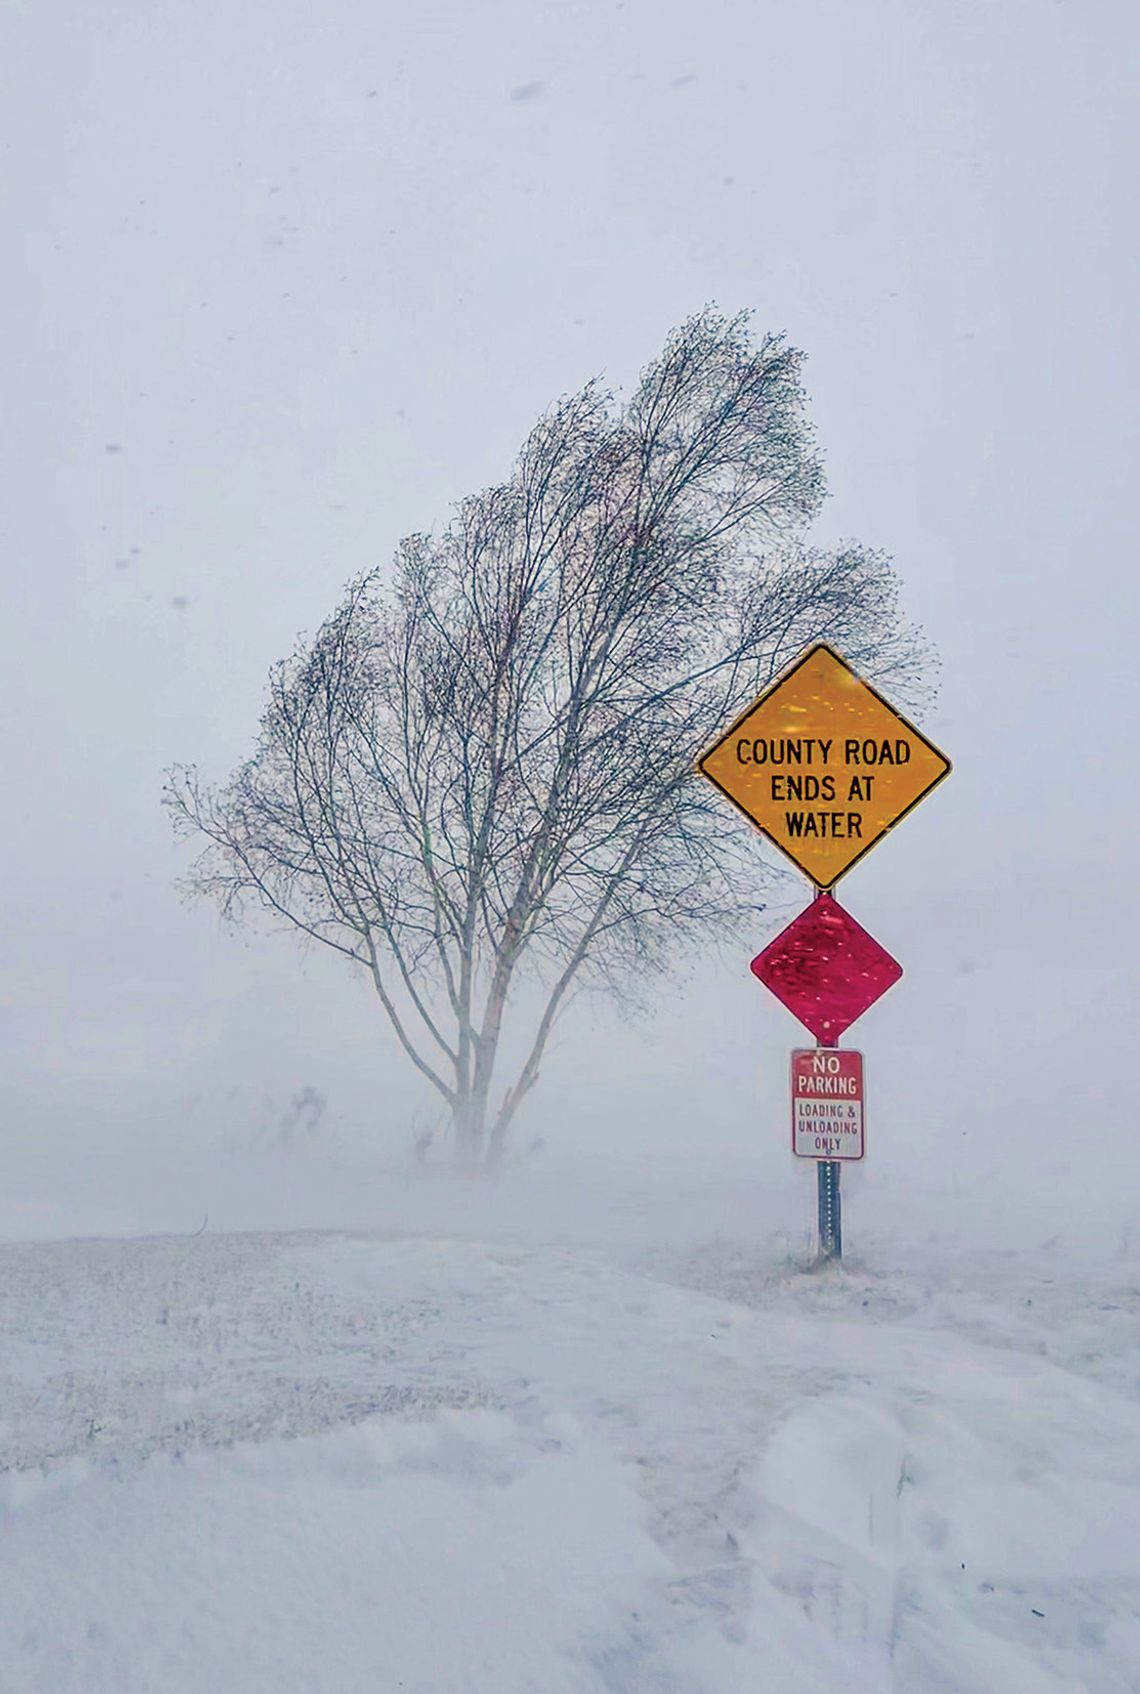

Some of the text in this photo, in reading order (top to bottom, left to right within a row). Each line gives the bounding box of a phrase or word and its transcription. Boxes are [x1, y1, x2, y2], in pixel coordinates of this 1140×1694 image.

[736, 739, 911, 765] COUNTY ROAD
[771, 775, 875, 801] ENDS AT
[786, 812, 863, 838] WATER
[813, 1056, 840, 1074] NO
[798, 1075, 857, 1094] PARKING
[799, 1104, 856, 1118] LOADING &
[798, 1120, 858, 1134] UNLOADING
[815, 1137, 841, 1150] ONLY
